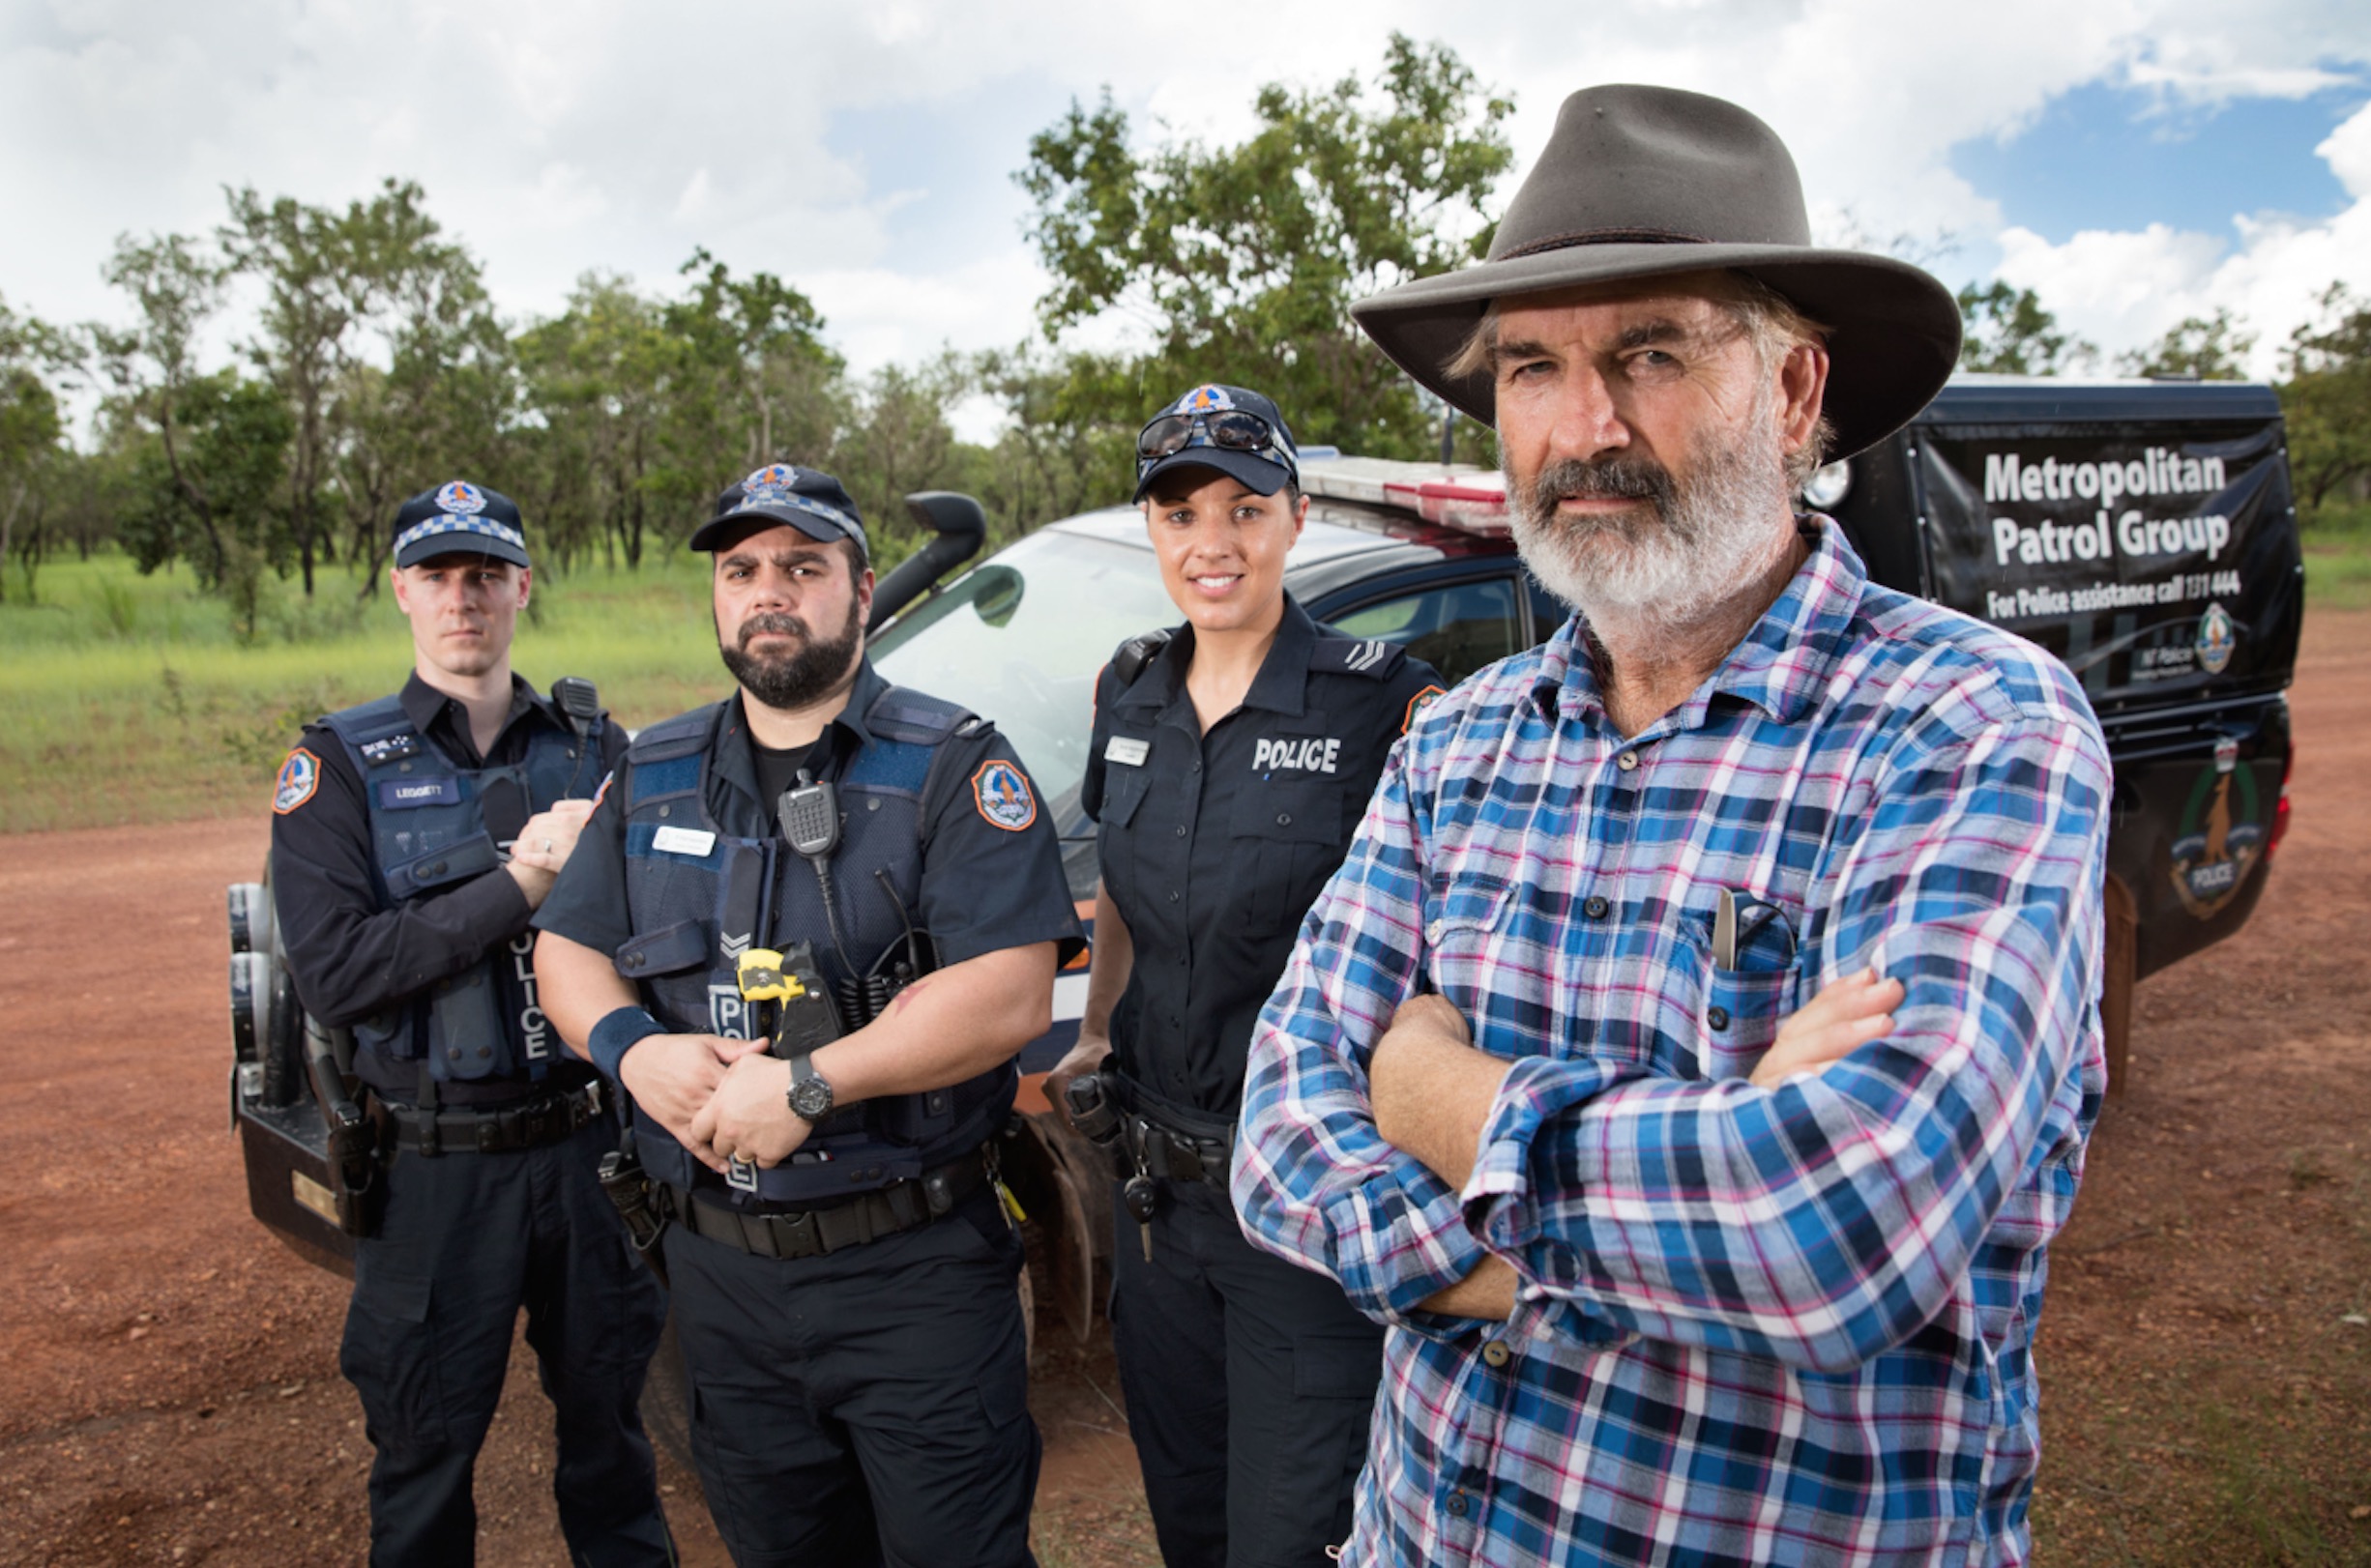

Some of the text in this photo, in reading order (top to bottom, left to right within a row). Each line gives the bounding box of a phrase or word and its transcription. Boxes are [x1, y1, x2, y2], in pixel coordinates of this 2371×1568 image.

[1985, 447, 2226, 508] Metropolitan
[1993, 509, 2230, 566] Patrol Group
[1986, 569, 2241, 619] For Police assistance call 131 444
[1251, 738, 1341, 774] POLICE
[395, 784, 442, 799] LEGGETT
[2193, 862, 2234, 888] POLICE
